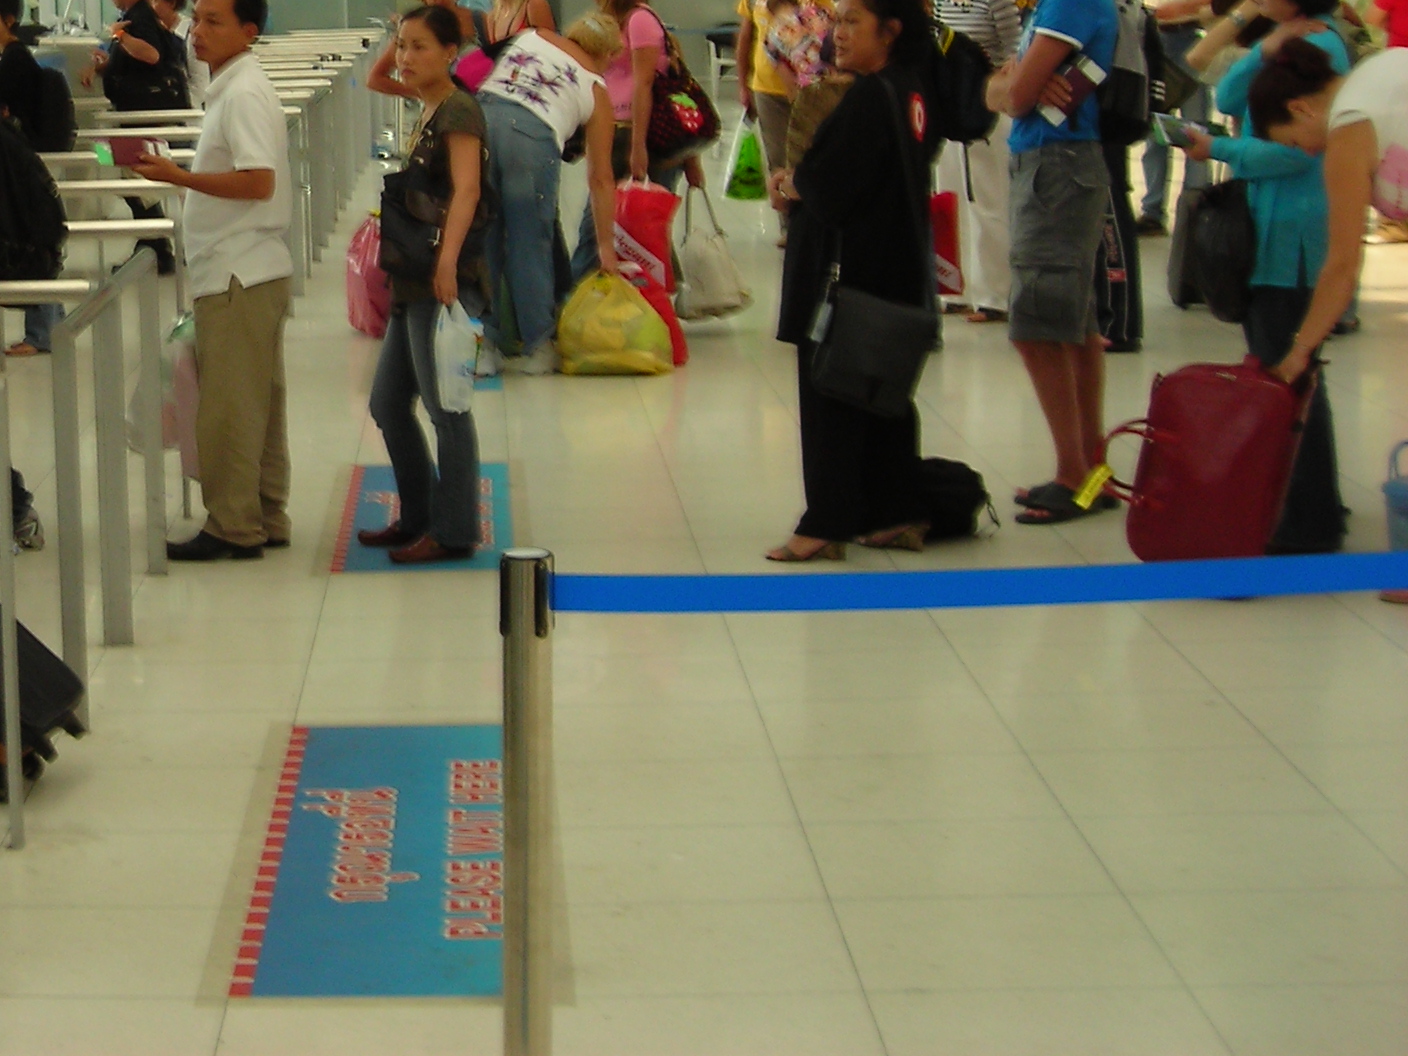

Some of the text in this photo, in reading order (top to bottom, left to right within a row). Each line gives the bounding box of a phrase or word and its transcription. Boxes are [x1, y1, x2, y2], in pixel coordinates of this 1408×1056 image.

[444, 759, 503, 940] PLEASE WAIT HERE
